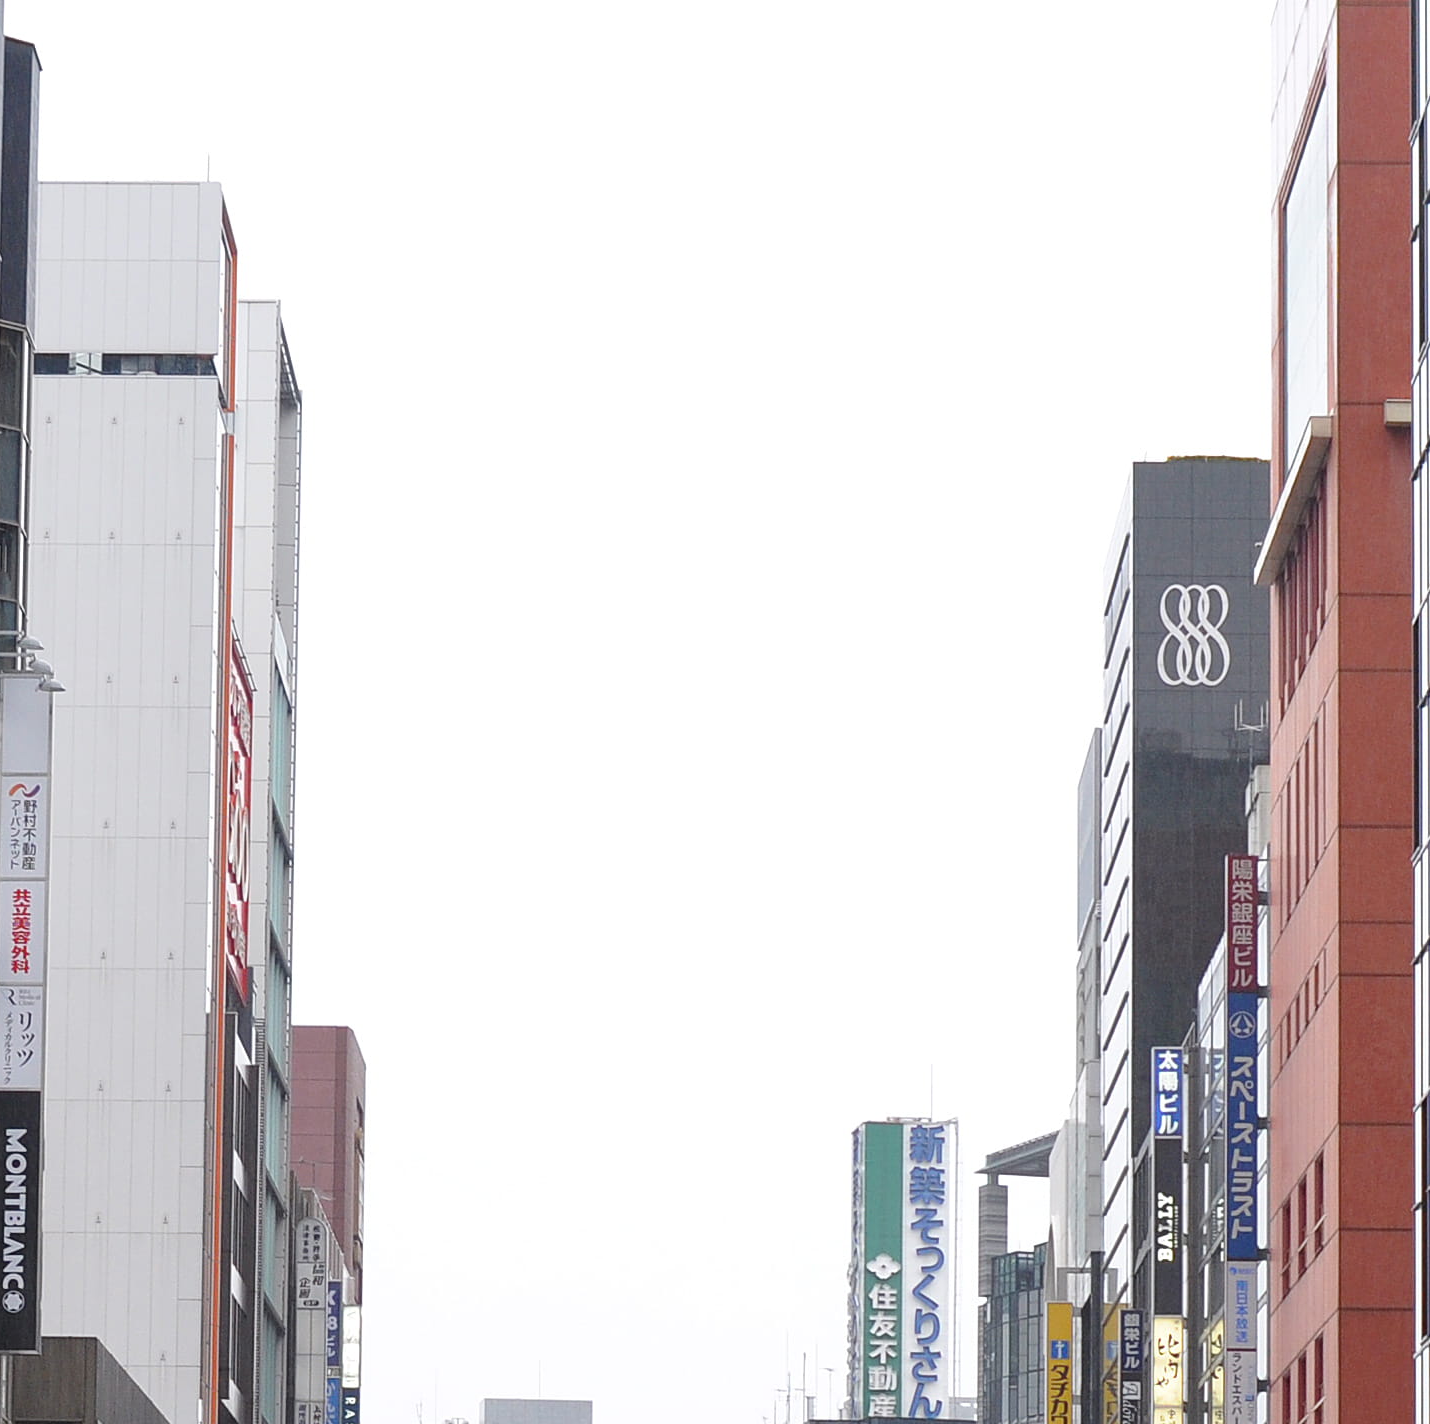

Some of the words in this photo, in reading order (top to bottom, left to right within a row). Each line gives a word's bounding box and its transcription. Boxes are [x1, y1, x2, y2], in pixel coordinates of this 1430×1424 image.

[9, 798, 21, 869] アーバンネット
[22, 799, 36, 870] 野村不動産
[11, 888, 31, 974] 共立美容外科
[1230, 859, 1254, 989] 陽栄銀座ビル
[17, 1011, 34, 1067] リッツ
[1157, 1051, 1179, 1136] 太陽ビル
[1230, 1055, 1255, 1240] スペーストラスト
[5, 1126, 28, 1288] MONTBLANC
[1158, 1192, 1174, 1262] BALLY
[868, 1284, 898, 1417] 住友不動産
